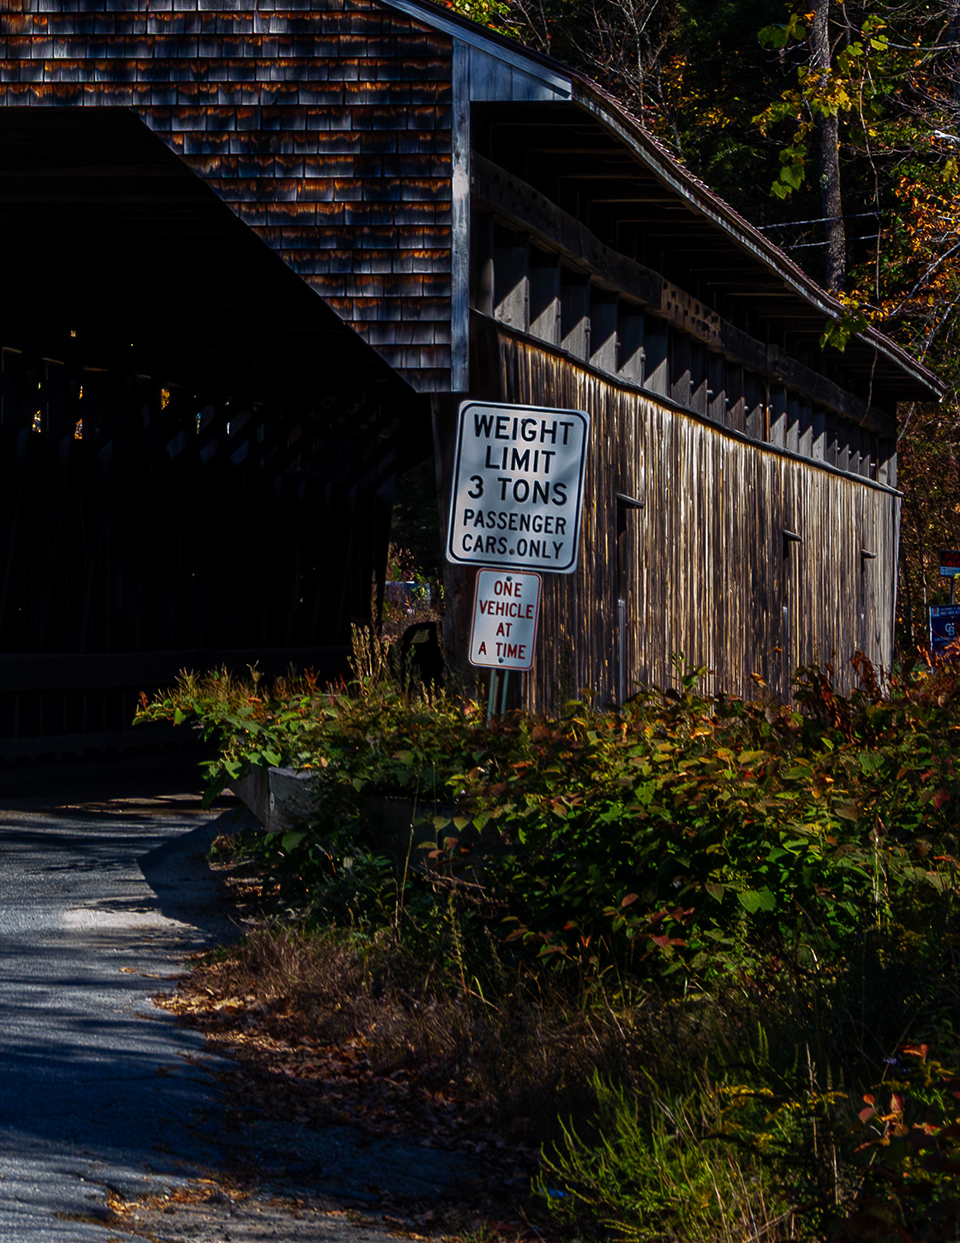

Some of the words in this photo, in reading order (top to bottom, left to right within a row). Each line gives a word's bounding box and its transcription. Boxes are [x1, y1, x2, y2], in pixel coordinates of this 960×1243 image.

[474, 414, 574, 445] WEIGHT
[485, 445, 556, 474] LIMIT
[467, 475, 484, 499] 3
[497, 477, 568, 506] TONS
[463, 508, 567, 536] PASSENGER
[462, 534, 508, 555] CARS
[516, 538, 564, 560] ONLY
[494, 580, 523, 598] ONE
[479, 599, 535, 620] VEHICLE
[496, 622, 513, 638] AT
[478, 641, 488, 656] A
[495, 642, 527, 660] TIME
